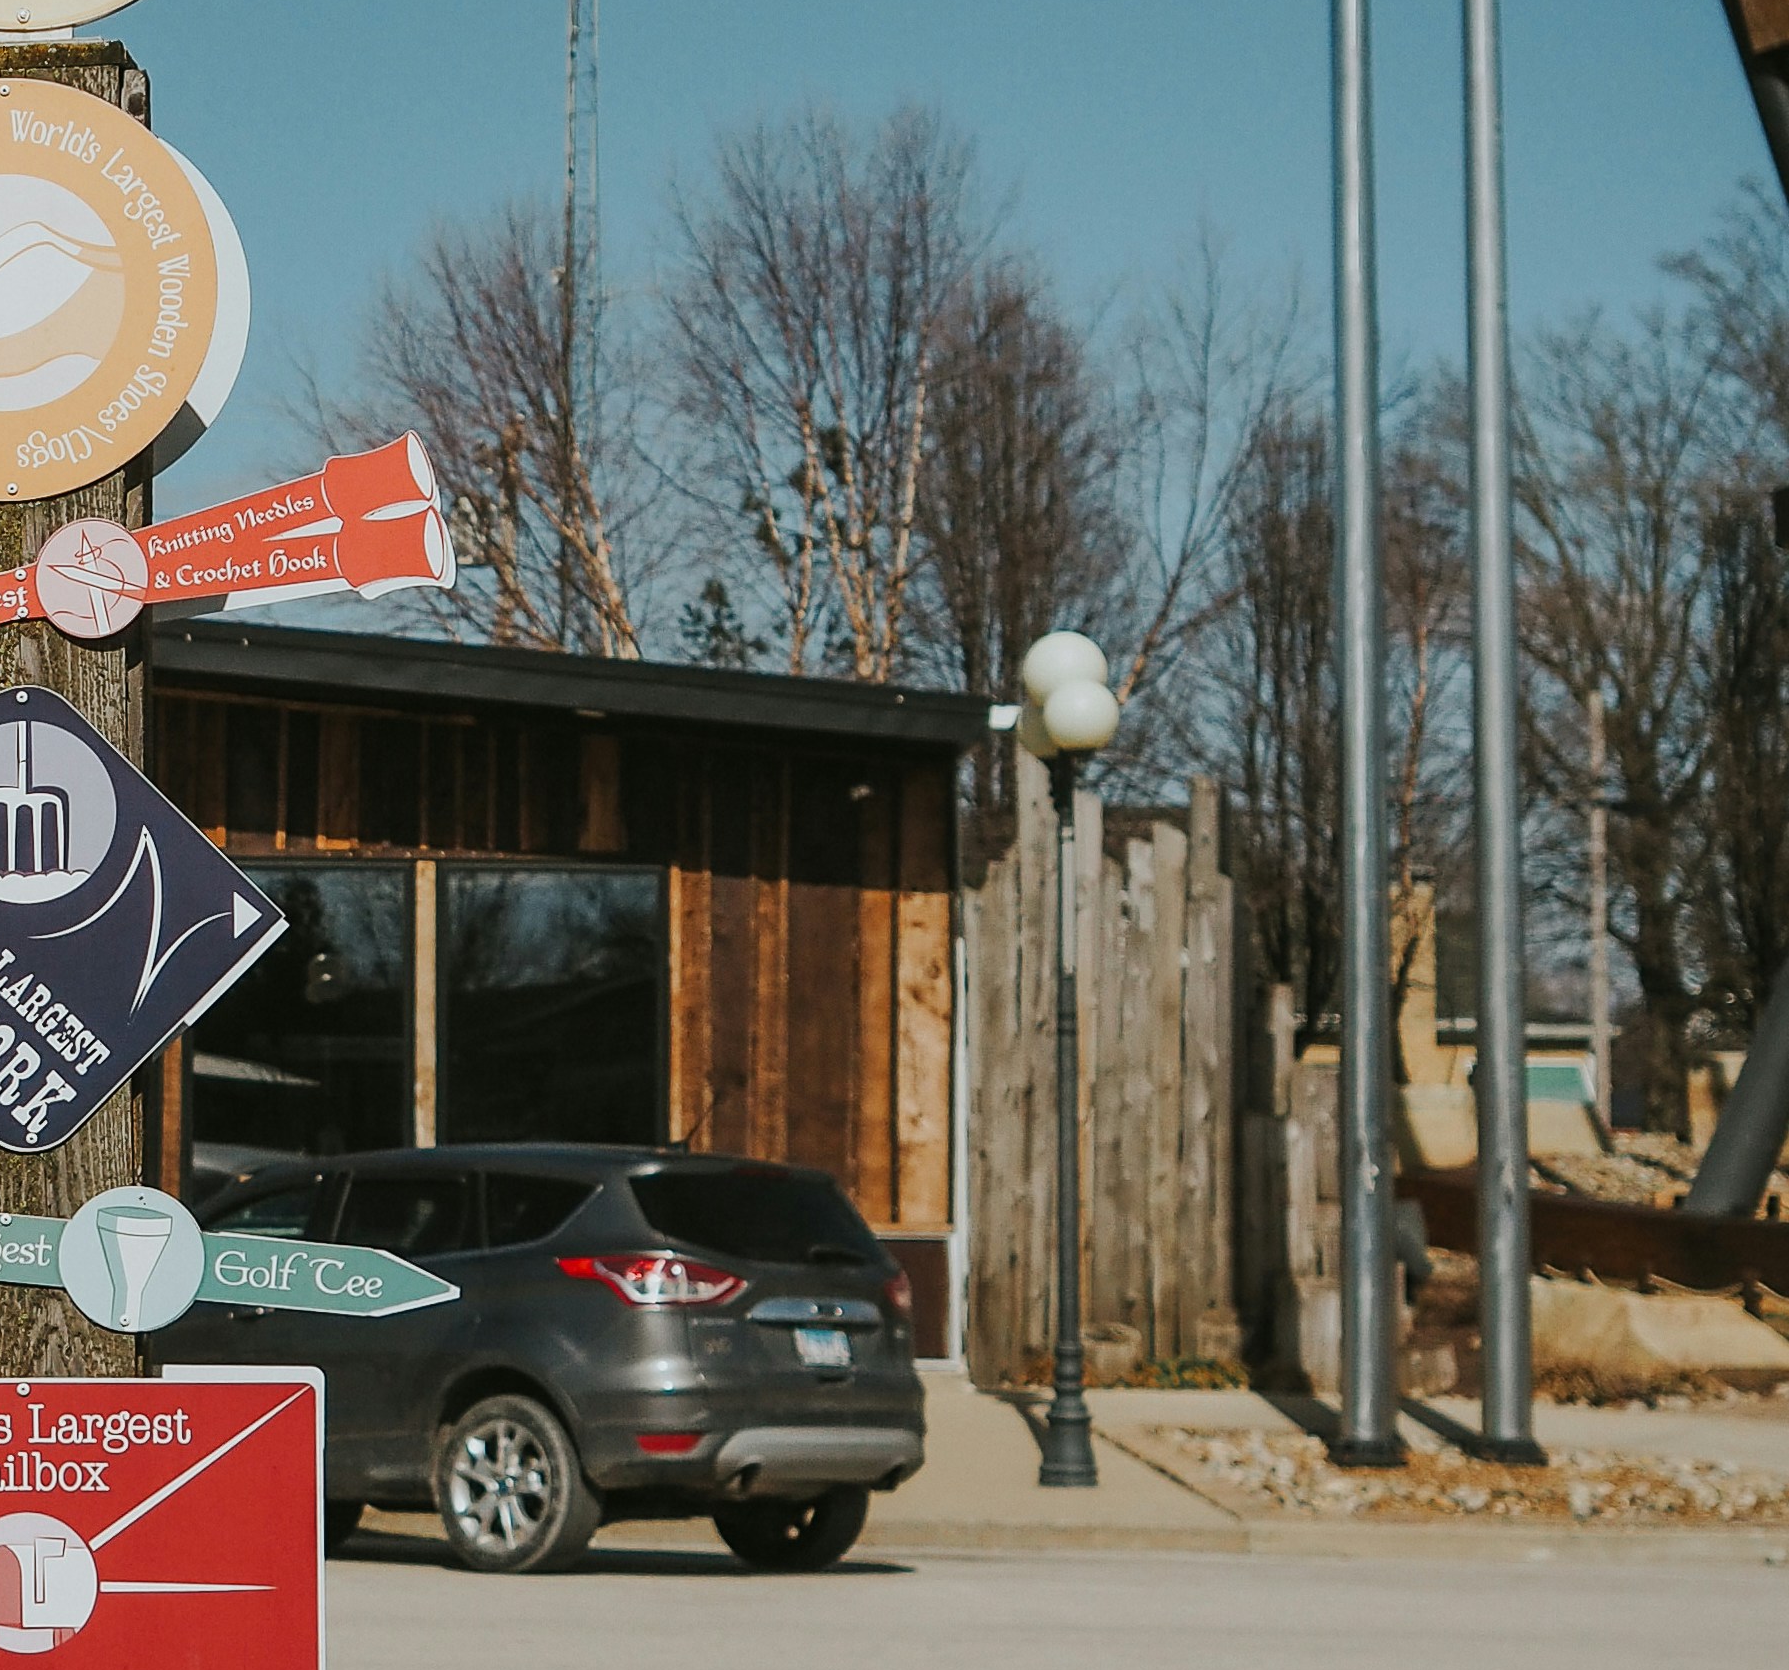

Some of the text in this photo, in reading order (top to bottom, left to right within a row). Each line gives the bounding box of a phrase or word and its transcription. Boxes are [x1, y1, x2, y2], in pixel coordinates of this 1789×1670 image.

[10, 109, 102, 164] World's
[100, 147, 182, 250] Largest
[148, 253, 191, 358] Wooden
[147, 494, 315, 559] Knitting Needles
[154, 545, 328, 590] & Crochet Hook
[214, 1250, 308, 1291] Golf
[309, 1258, 383, 1298] Tee
[27, 1403, 192, 1454] Largest
